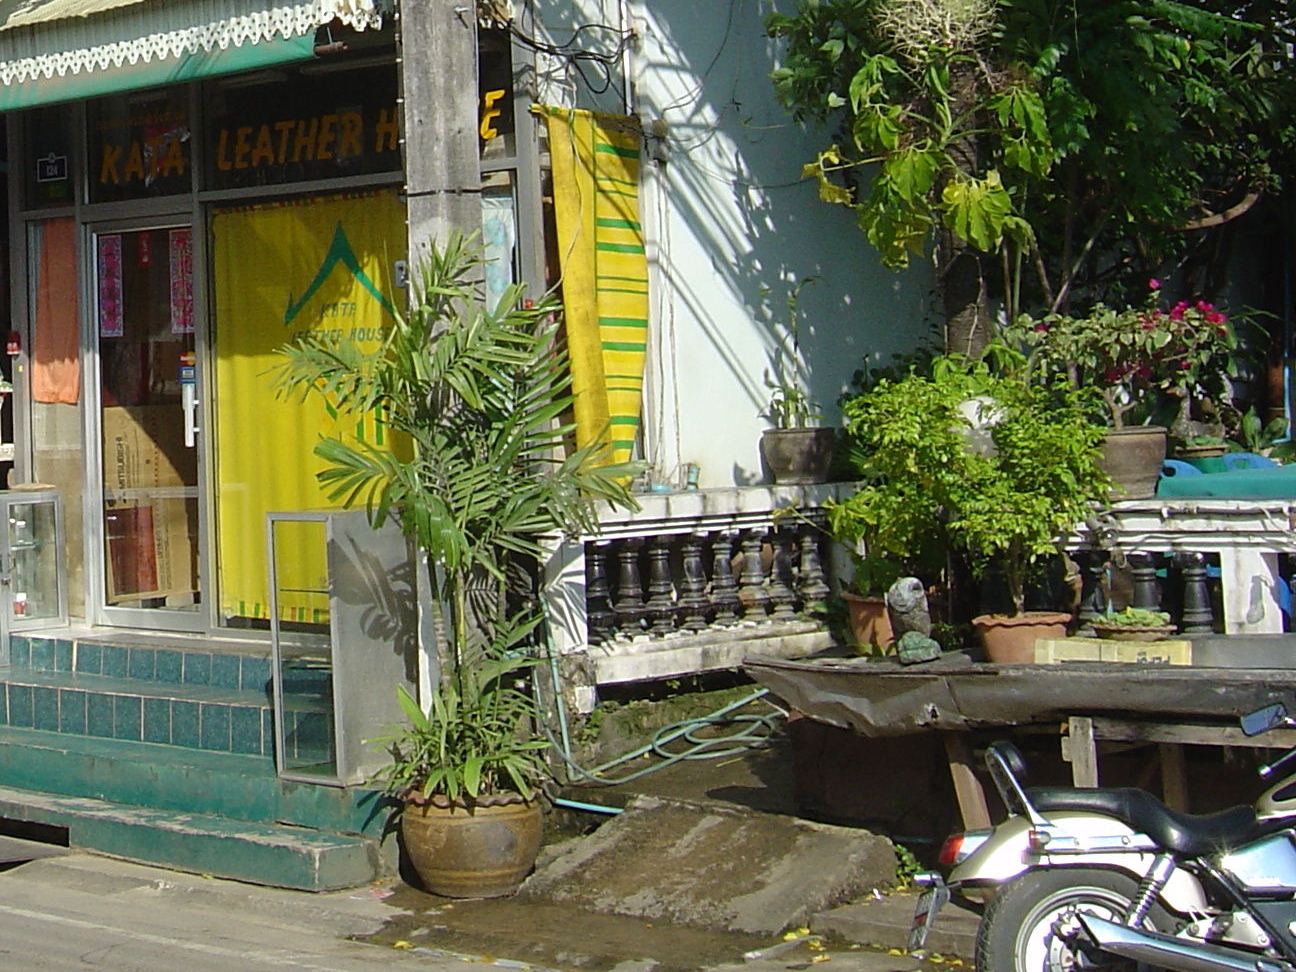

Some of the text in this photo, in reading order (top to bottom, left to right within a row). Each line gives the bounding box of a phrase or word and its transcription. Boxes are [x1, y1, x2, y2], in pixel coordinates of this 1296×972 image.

[100, 136, 185, 185] KATA
[217, 111, 364, 171] LEATHER
[322, 302, 356, 318] KATA
